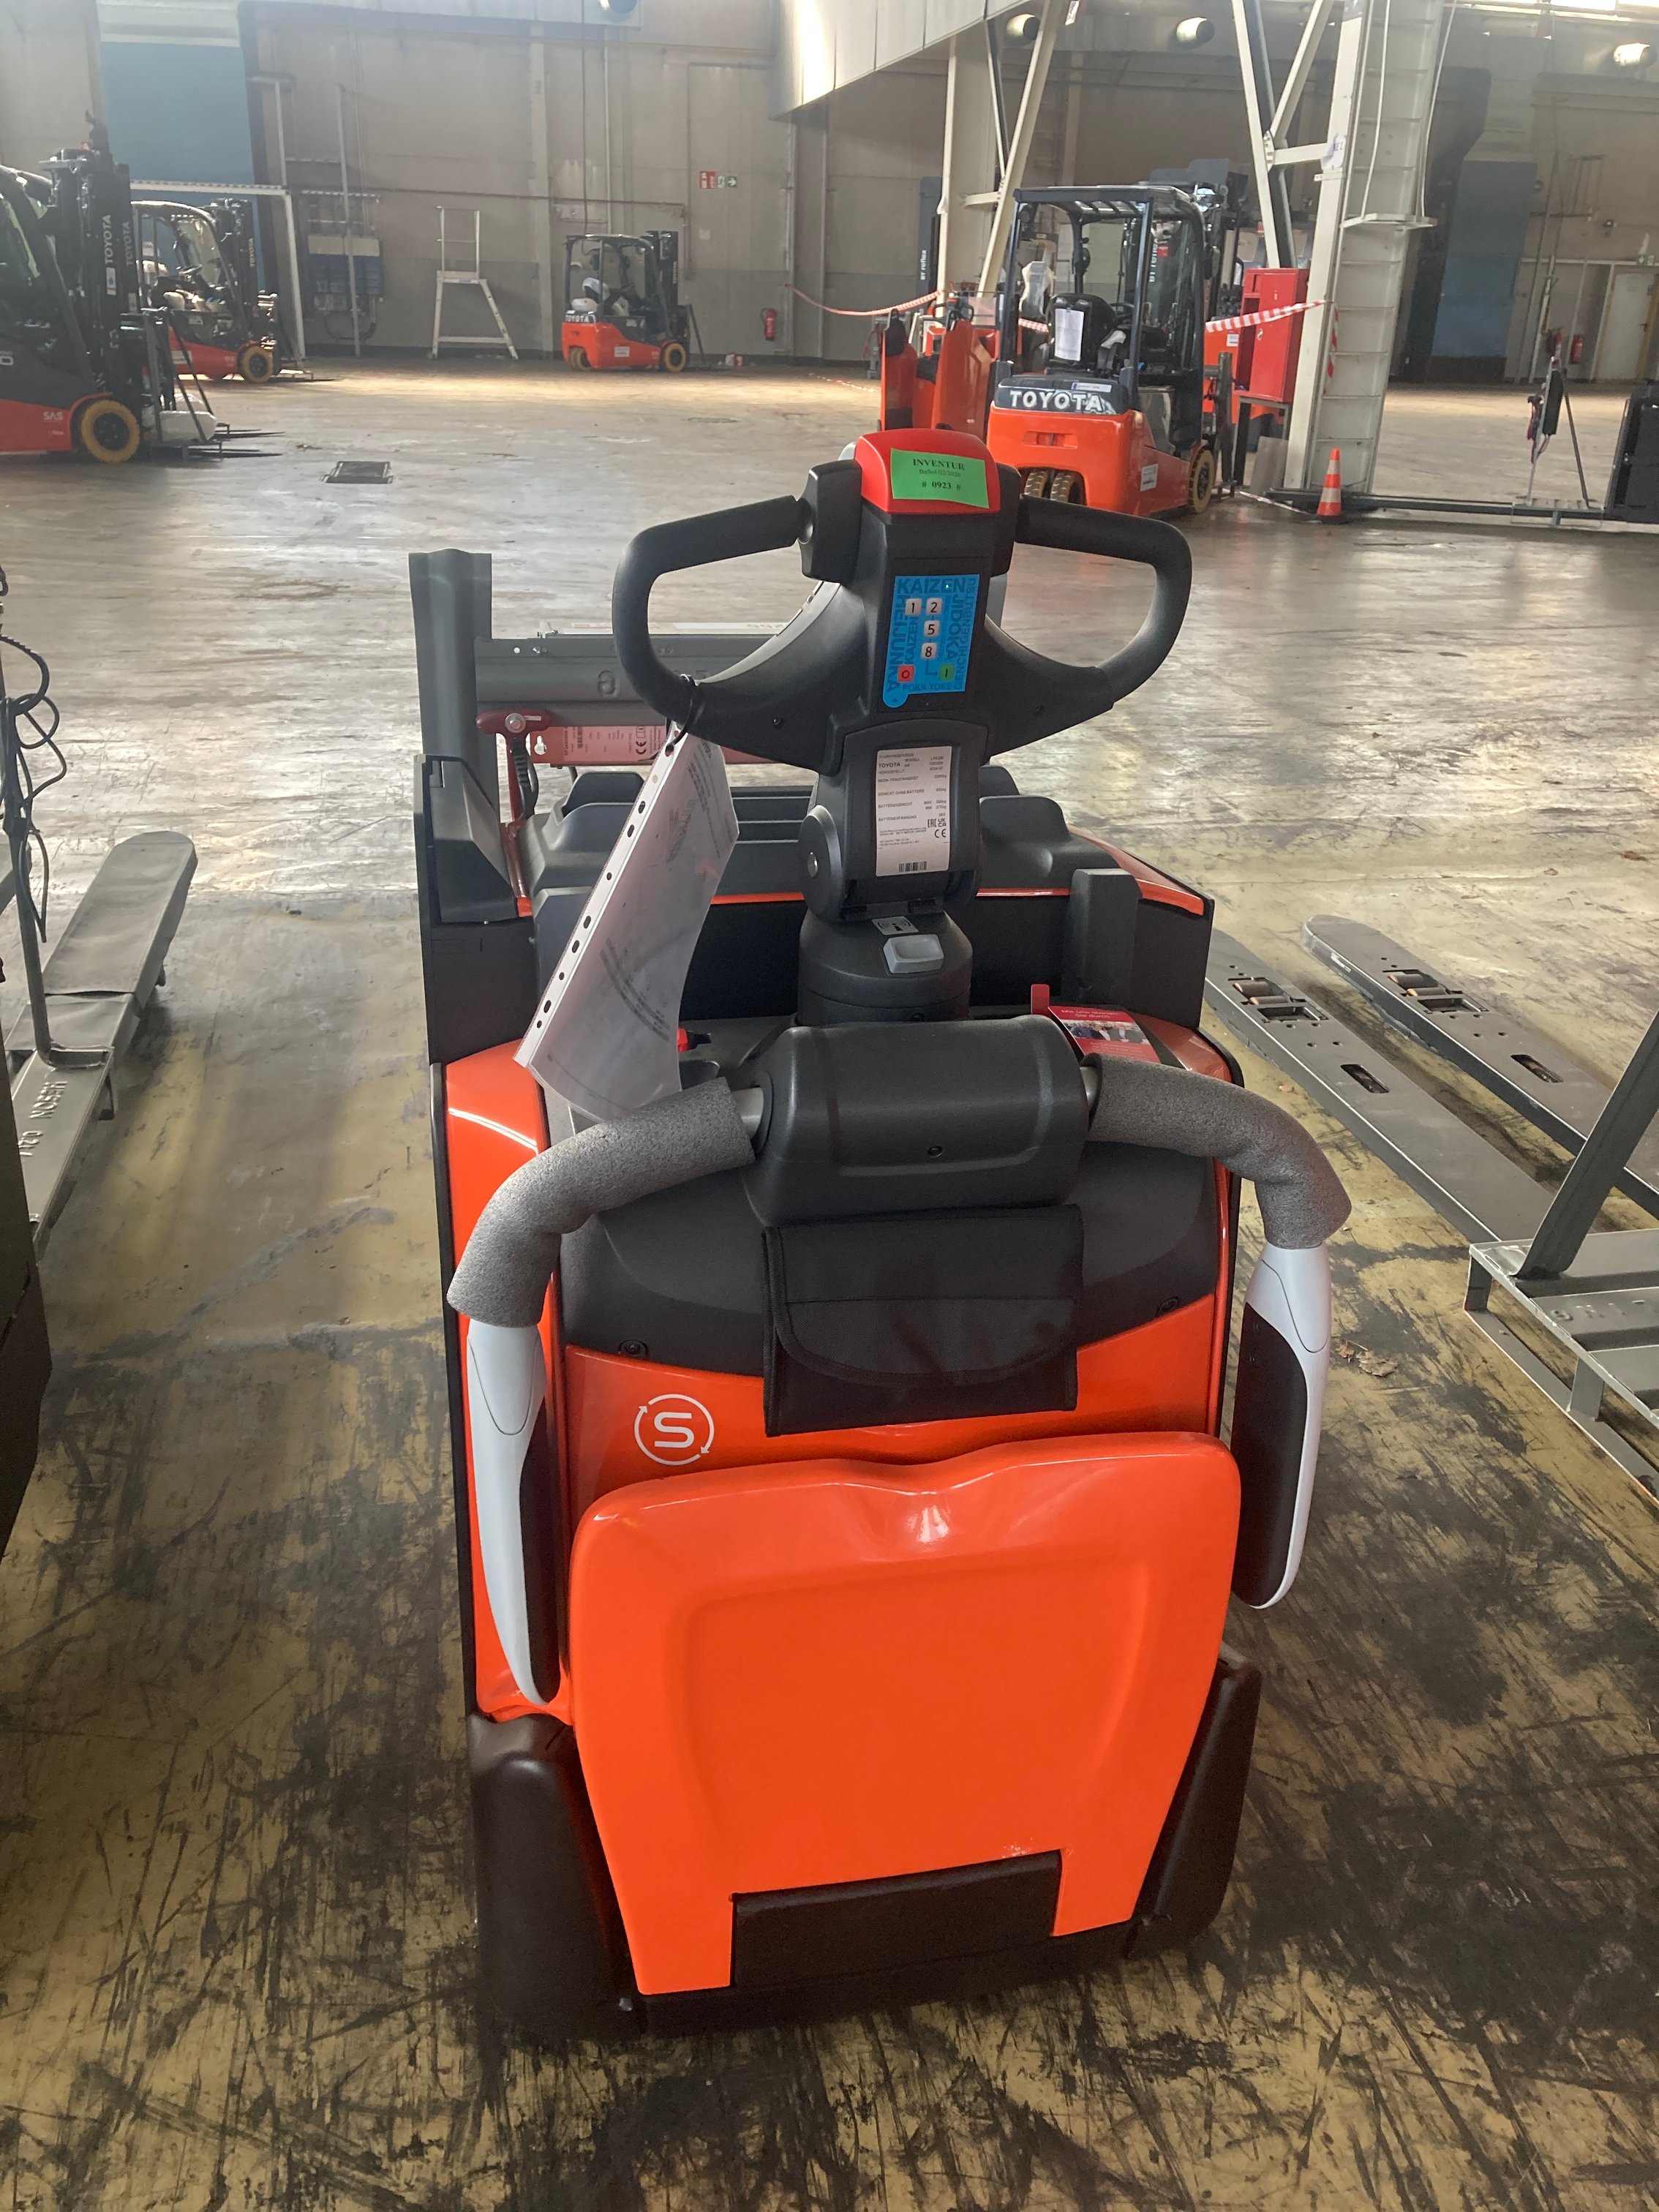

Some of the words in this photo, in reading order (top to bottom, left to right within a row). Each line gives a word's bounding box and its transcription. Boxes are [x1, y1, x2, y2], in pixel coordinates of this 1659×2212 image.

[102, 215, 114, 264] TOYOTA
[122, 222, 133, 266] TOYOTA
[565, 315, 590, 323] TOYOTA
[1009, 390, 1103, 412] TOYOTA
[43, 411, 64, 421] SAS
[913, 459, 966, 470] INVENTUR
[932, 481, 952, 489] 0923
[897, 578, 966, 594] KAIZEN
[911, 602, 915, 613] 1
[930, 602, 938, 613] 2
[928, 624, 935, 635] 5
[945, 593, 964, 661] JIDOKA
[925, 646, 933, 658] 8
[903, 683, 926, 691] POKA
[930, 682, 952, 691] YOKE
[934, 829, 947, 838] CE
